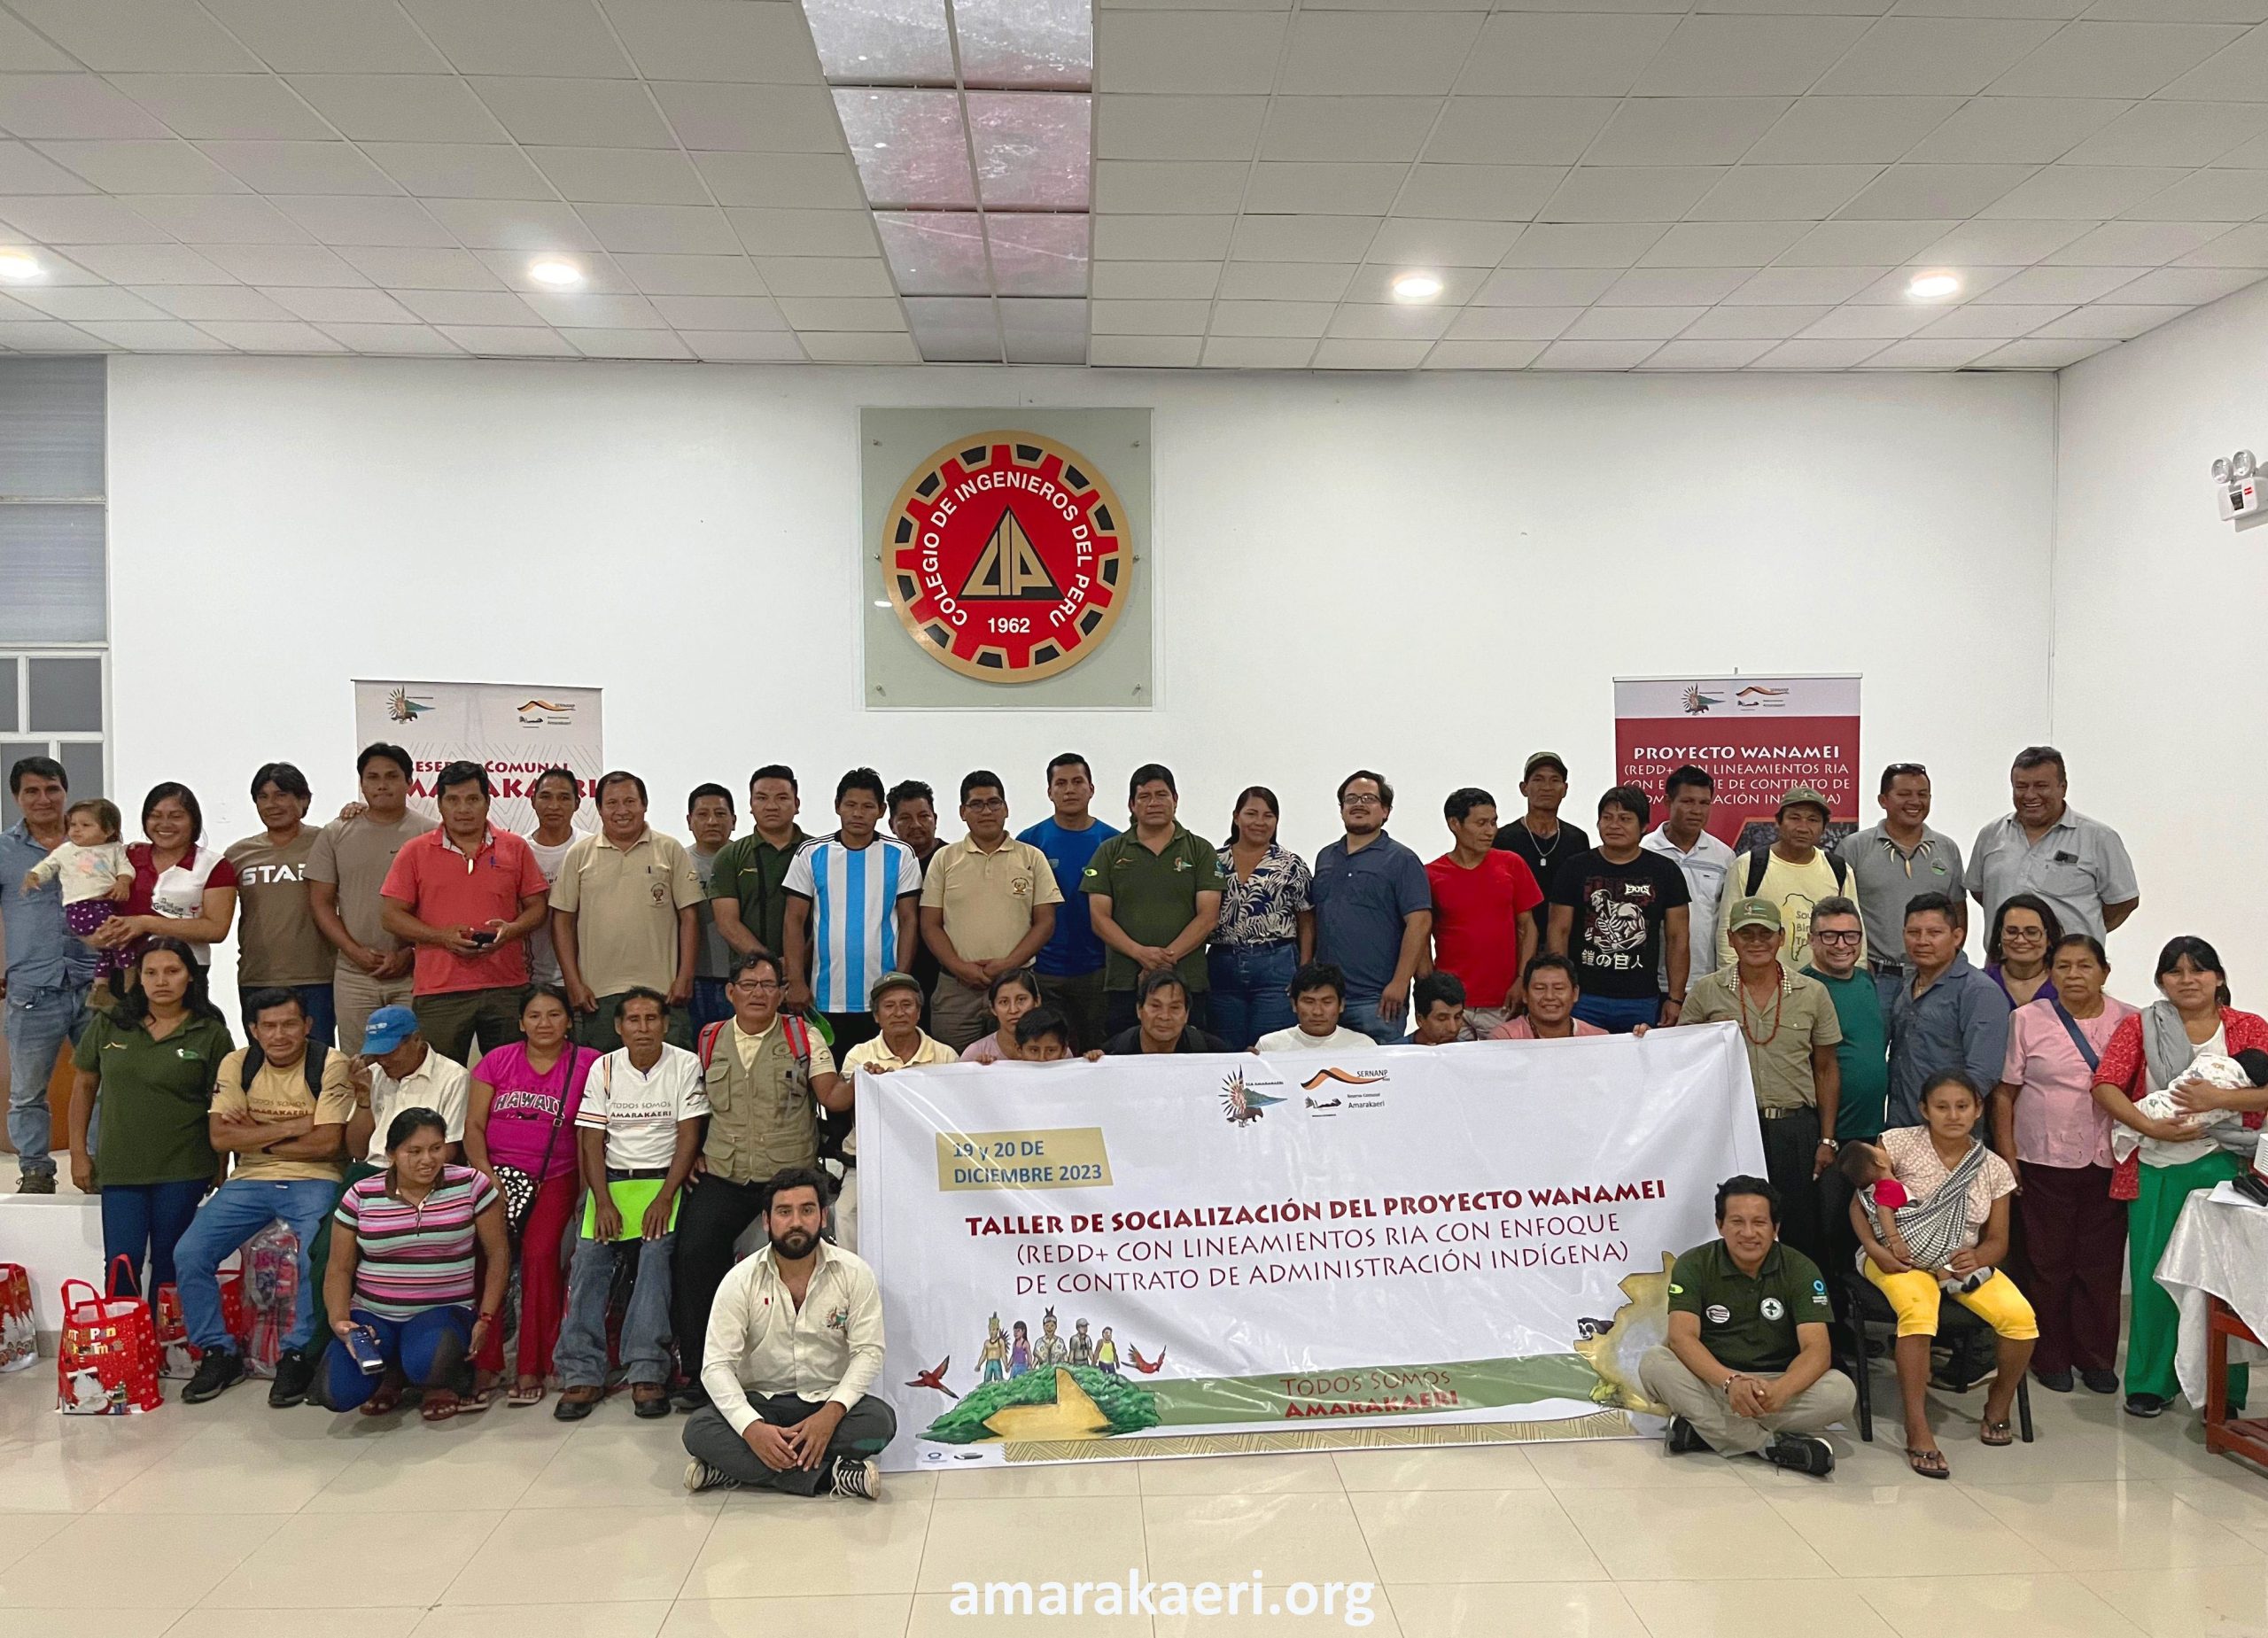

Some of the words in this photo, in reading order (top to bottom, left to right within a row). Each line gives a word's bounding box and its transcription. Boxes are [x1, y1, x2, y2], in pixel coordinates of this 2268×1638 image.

[954, 471, 1079, 521] INGENIEROS
[930, 497, 957, 528] DE
[1071, 524, 1092, 567] DEL
[922, 532, 967, 626] COLEGIO
[1049, 573, 1090, 628] PERU
[987, 617, 1030, 633] 1962
[1634, 746, 1735, 760] PROYECTO
[1740, 745, 1840, 759] WANAMEI
[1624, 765, 1674, 776] (REDD+
[1713, 764, 1819, 774] LINEAMIENTOS
[1824, 764, 1849, 774] RIA
[1728, 779, 1745, 789] DE
[1750, 779, 1828, 789] CONTRATO
[1833, 779, 1850, 789] DE
[641, 1100, 672, 1109] SOMOS
[1348, 1100, 1385, 1109] Amarakaeri
[953, 1142, 973, 1158] 19
[994, 1142, 1015, 1158] 20
[1021, 1140, 1045, 1156] DE
[954, 1166, 1052, 1184] DICIEMBRE
[1059, 1164, 1102, 1181] 2023
[965, 1215, 1064, 1237] TALLER
[1070, 1213, 1104, 1234] DE
[1112, 1198, 1322, 1232] SOCIALIZACIÓN
[1330, 1198, 1377, 1220] DEL
[1384, 1189, 1523, 1216] PROYECTO
[1527, 1179, 1666, 1208] WANAMEI
[1016, 1243, 1109, 1266] (REDD+
[1116, 1240, 1174, 1262] CON
[1183, 1227, 1376, 1259] LINEAMIENTOS
[1386, 1224, 1429, 1246] RIA
[1435, 1221, 1490, 1242] CON
[1501, 1213, 1620, 1238] ENFOQUE
[1016, 1274, 1047, 1295] DE
[1057, 1269, 1200, 1293] CONTRATO
[1208, 1266, 1240, 1287] DE
[1249, 1248, 1481, 1284] ADMINISTRACIÓN
[1492, 1240, 1629, 1269] INDÍGENA)
[1279, 1376, 1362, 1397] TODOS
[1370, 1370, 1451, 1391] SOMOS
[1285, 1389, 1459, 1419] AMARAKAERI
